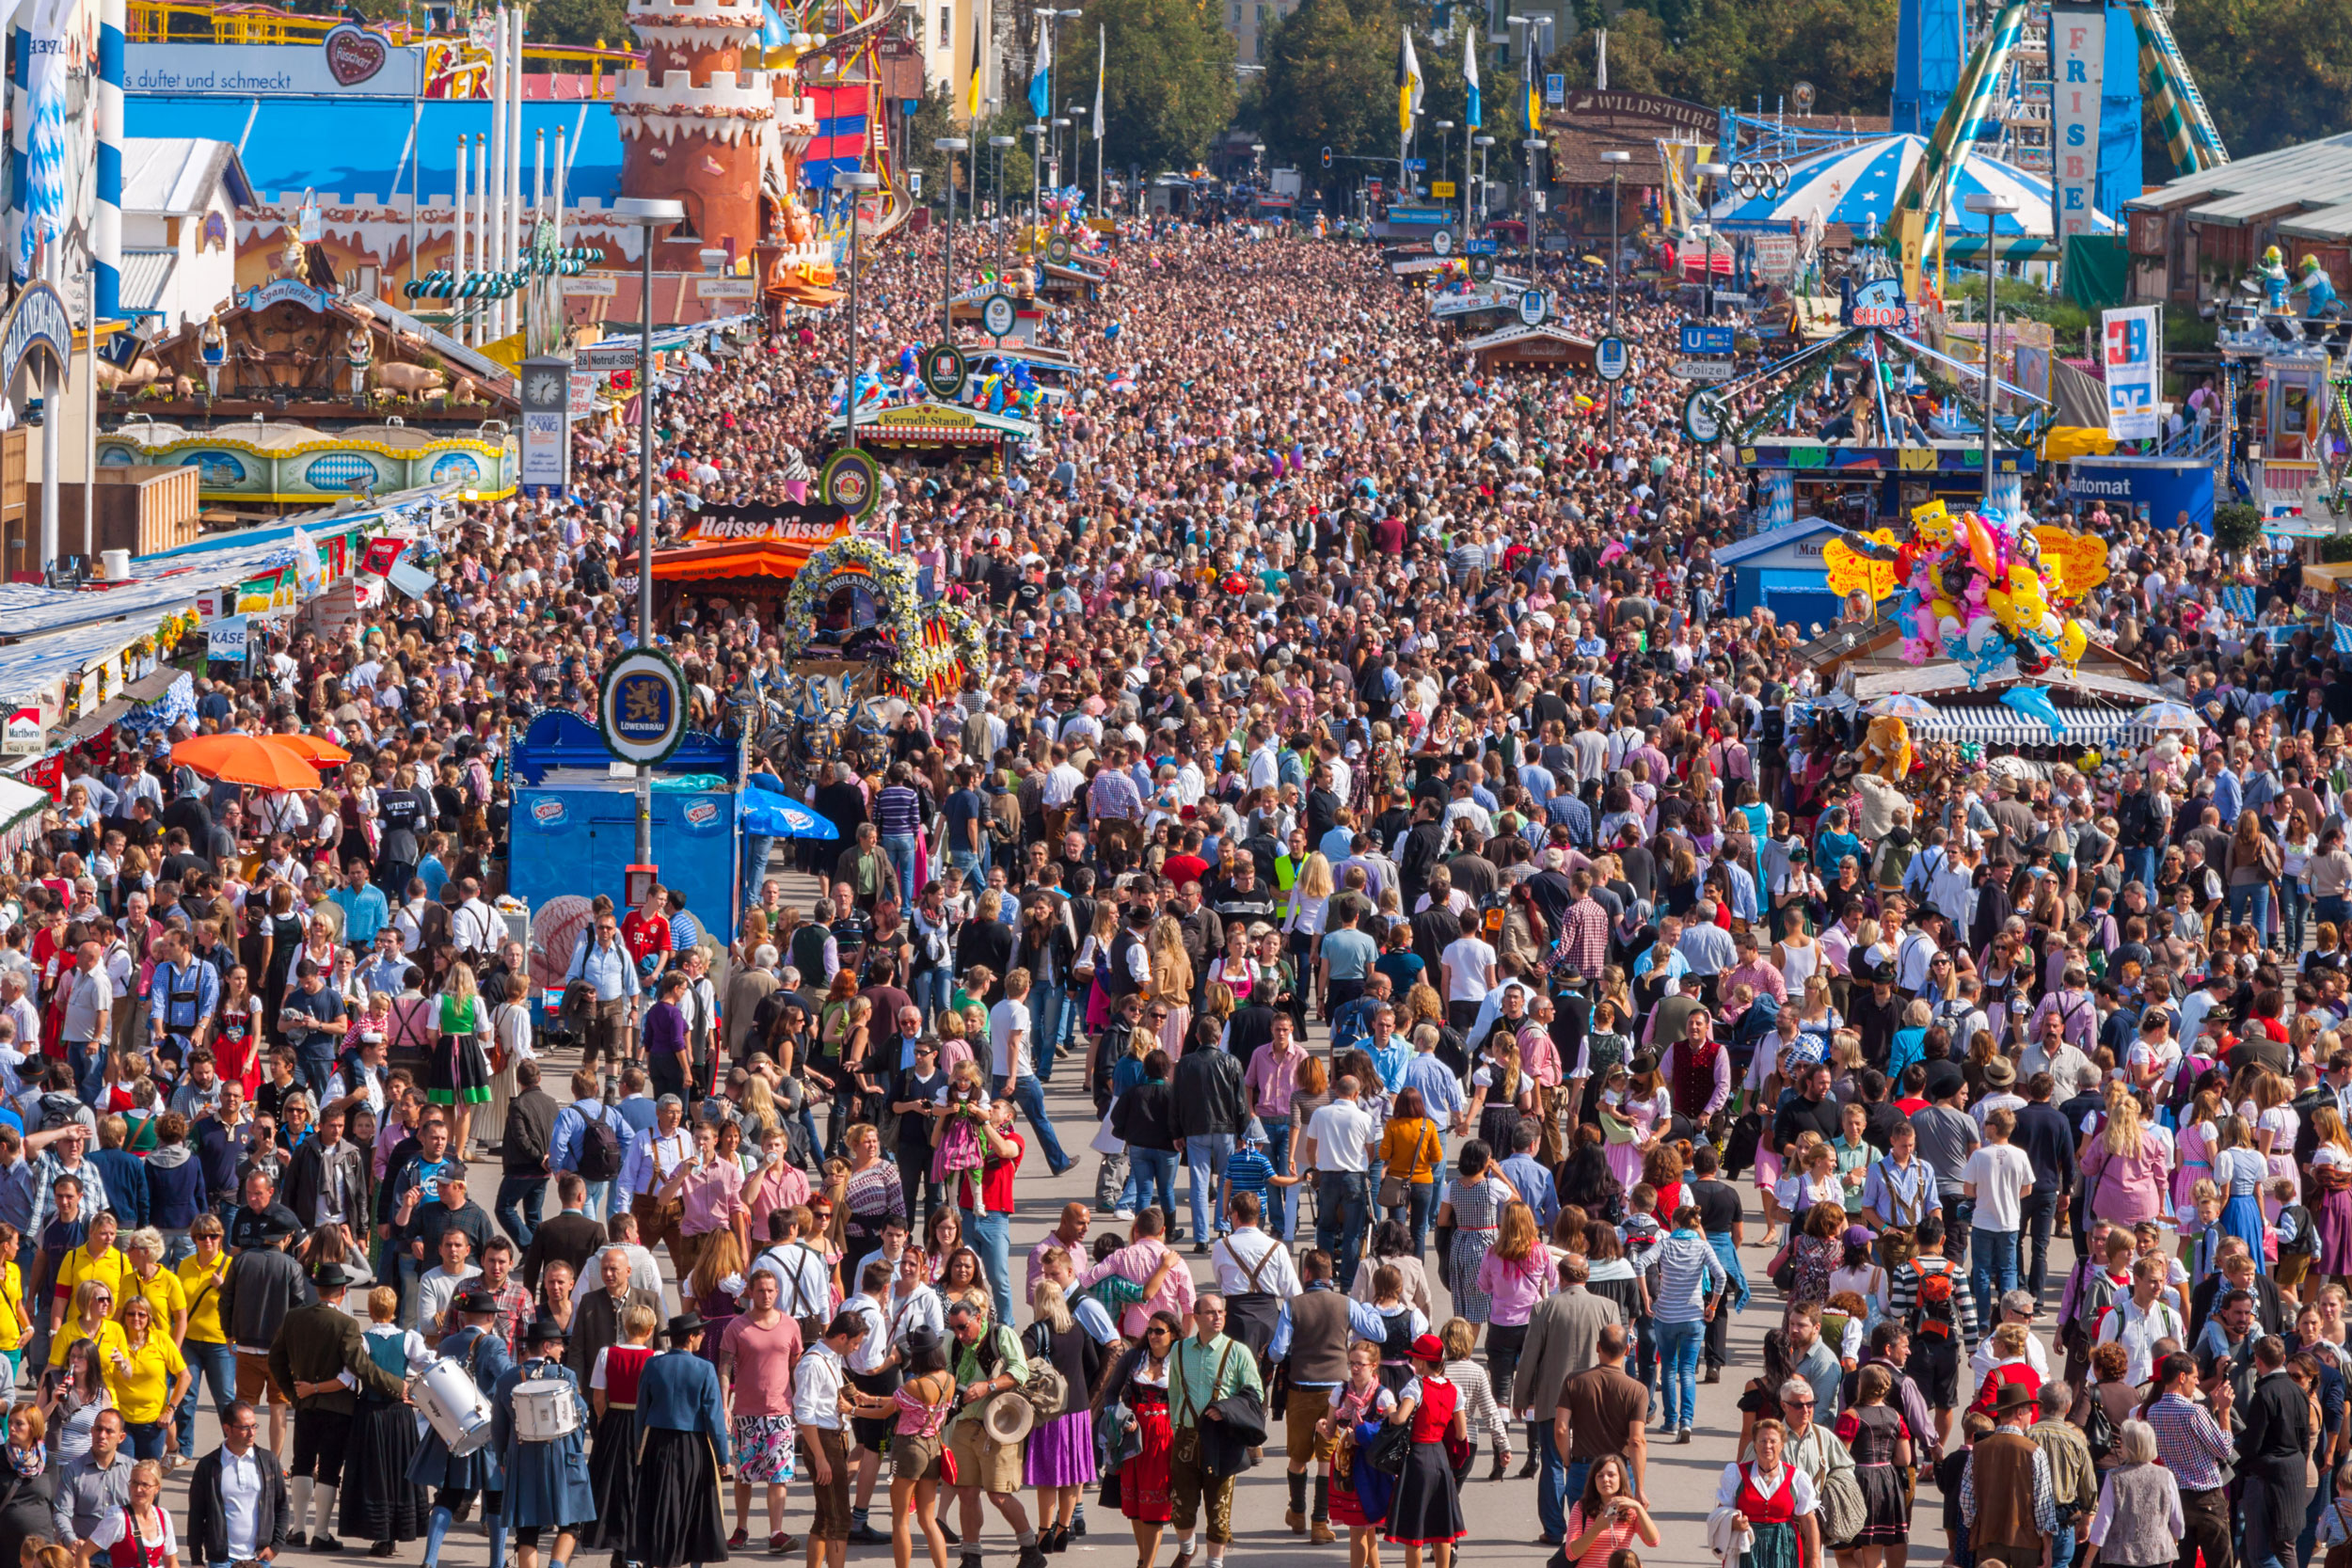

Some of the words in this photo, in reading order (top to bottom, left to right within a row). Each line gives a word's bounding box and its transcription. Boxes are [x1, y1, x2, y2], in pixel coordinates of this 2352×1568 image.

[137, 70, 182, 87] duftet
[186, 71, 215, 87] und
[220, 71, 291, 89] schmeckt
[1597, 95, 1717, 131] WILDSTUBE
[259, 284, 316, 303] Spanferkel
[1853, 308, 1906, 326] SHOP
[979, 338, 1024, 347] Madeln
[1688, 332, 1701, 348] U
[578, 356, 588, 366] 26
[591, 354, 636, 366] Notruf-SOS
[1687, 365, 1726, 375] Polizei
[883, 414, 971, 427] Kerndl-Standl
[2070, 478, 2131, 495] automat
[698, 515, 768, 538] Heisse
[772, 516, 835, 540] Nüsse
[681, 568, 706, 578] Heisse
[707, 566, 730, 576] Nüsse
[825, 575, 881, 594] PAULANER
[211, 629, 245, 644] KÄSE
[8, 728, 40, 738] Marlboro
[620, 721, 664, 732] LÖWENBRÄU
[386, 800, 415, 811] WIESN
